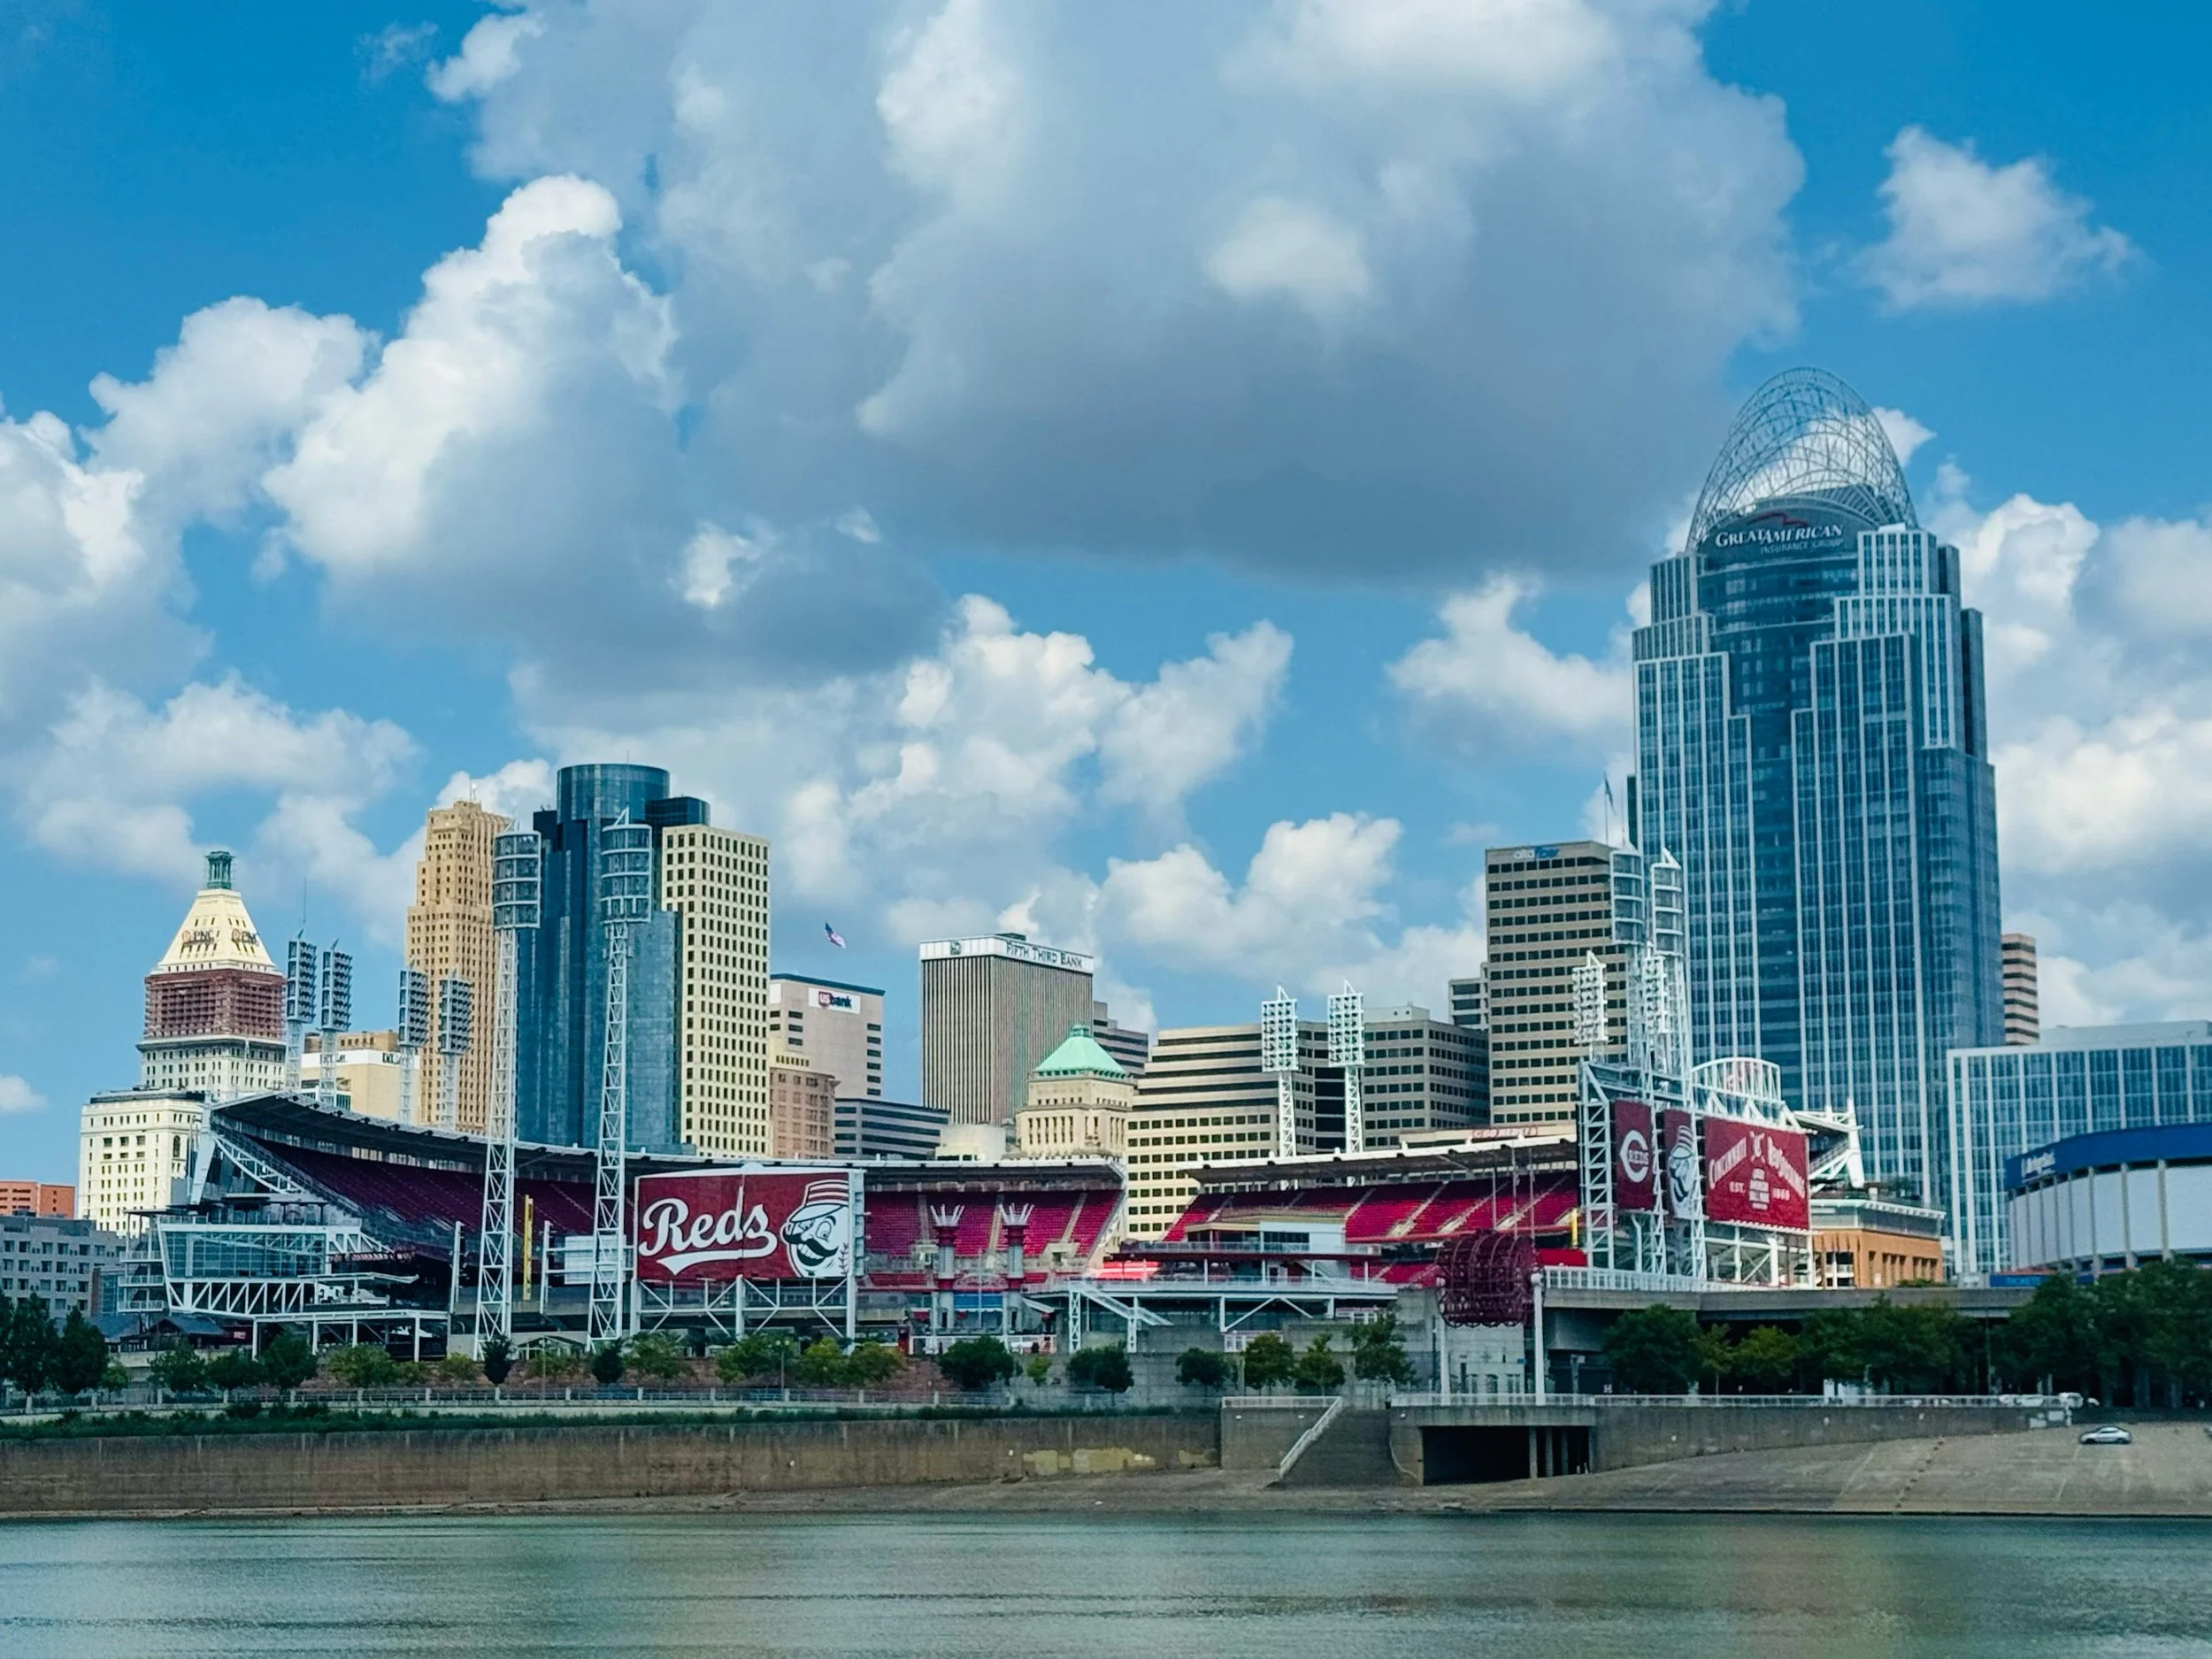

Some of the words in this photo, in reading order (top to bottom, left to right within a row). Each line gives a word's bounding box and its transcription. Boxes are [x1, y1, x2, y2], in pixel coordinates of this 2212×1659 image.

[1716, 530, 1763, 547] GREAT
[1760, 525, 1844, 544] AMERICAN
[1761, 541, 1809, 555] INSURANCE
[1812, 537, 1844, 548] GROUP
[194, 929, 214, 944] PNC
[1006, 941, 1029, 957] FIFTH
[1033, 947, 1058, 964] THIRD
[1060, 952, 1083, 969] BANK
[1628, 1149, 1649, 1165] REDS
[638, 1186, 778, 1276] Reds
